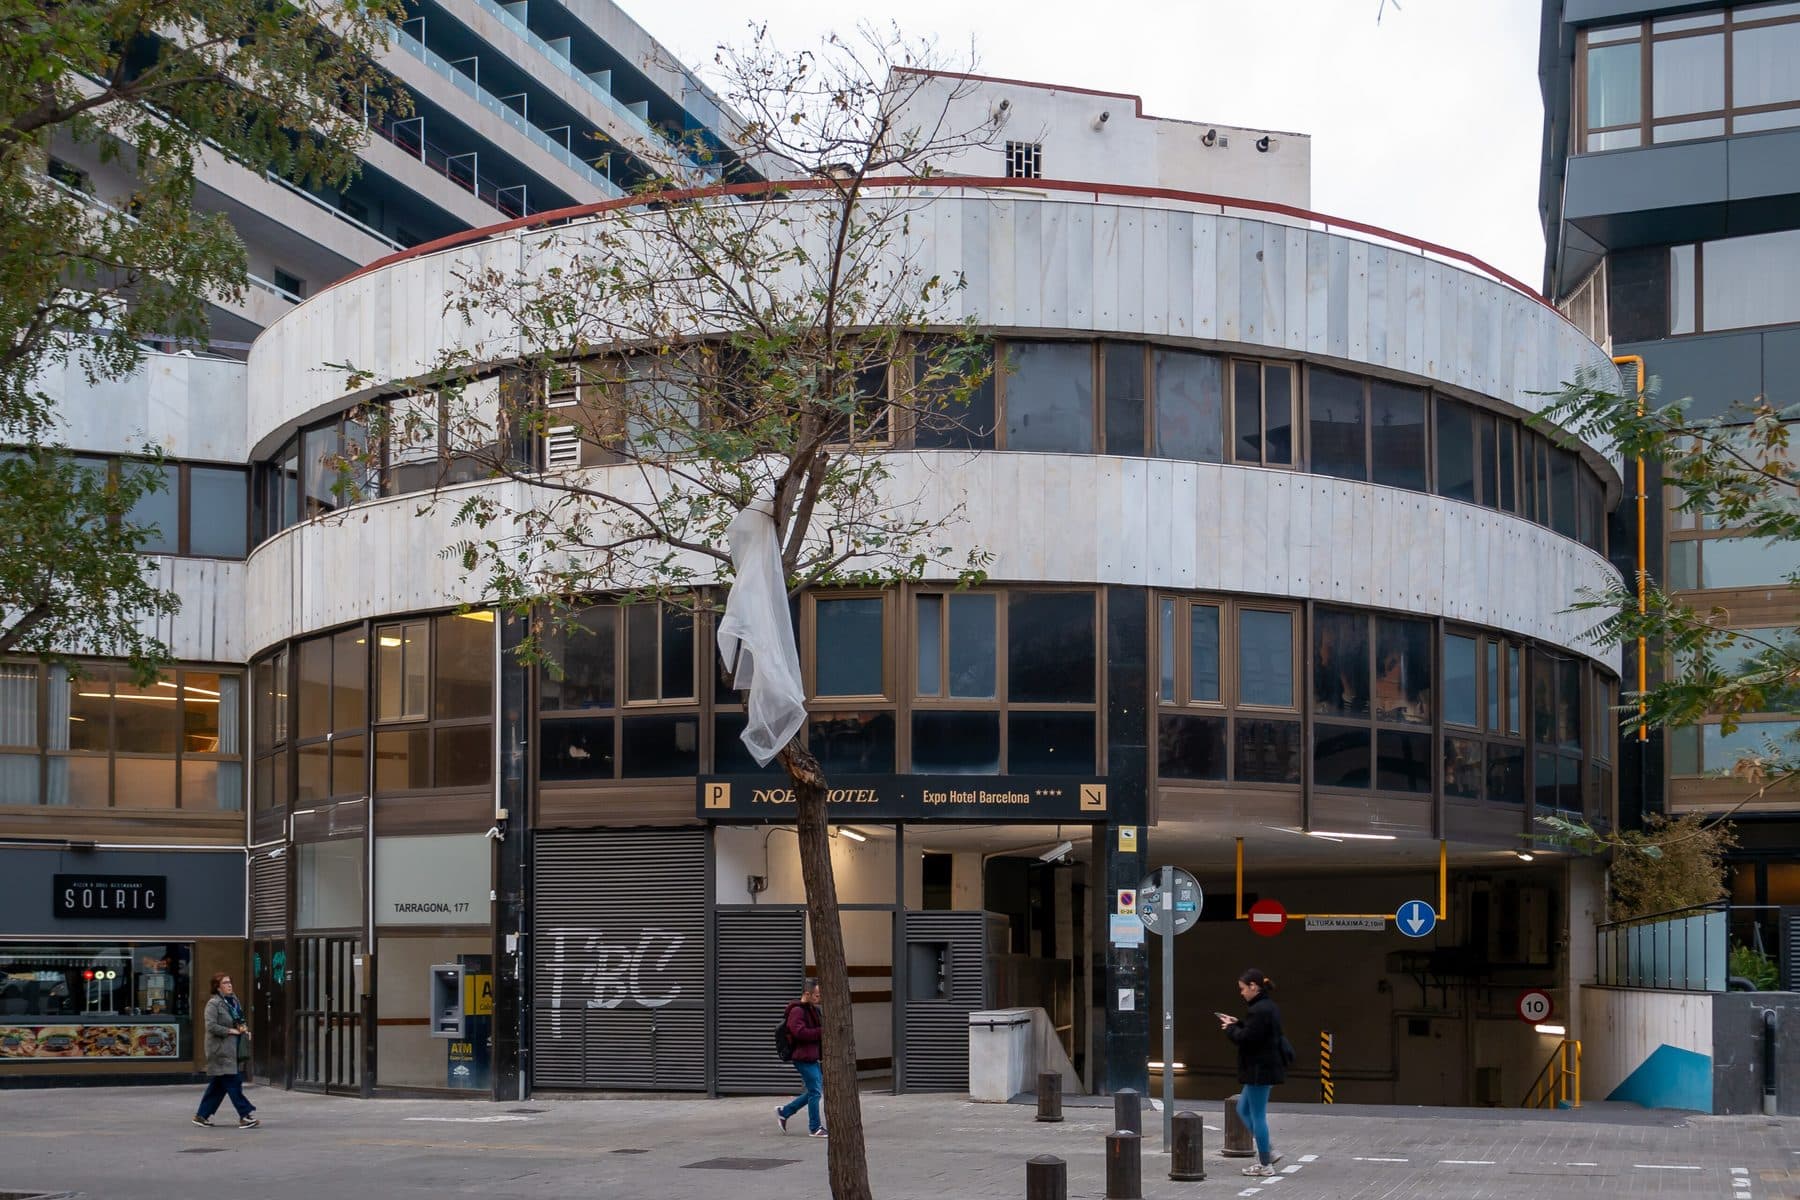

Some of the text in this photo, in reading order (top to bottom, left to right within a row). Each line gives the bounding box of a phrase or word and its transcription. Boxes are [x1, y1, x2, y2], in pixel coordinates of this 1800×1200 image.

[713, 786, 722, 805] P
[923, 790, 1030, 805] Expo Hotel Barcelona
[65, 889, 155, 909] SOLRIC
[394, 902, 470, 915] TARRAGONA, 177
[1526, 1001, 1544, 1013] 10
[451, 1043, 472, 1054] ATM
